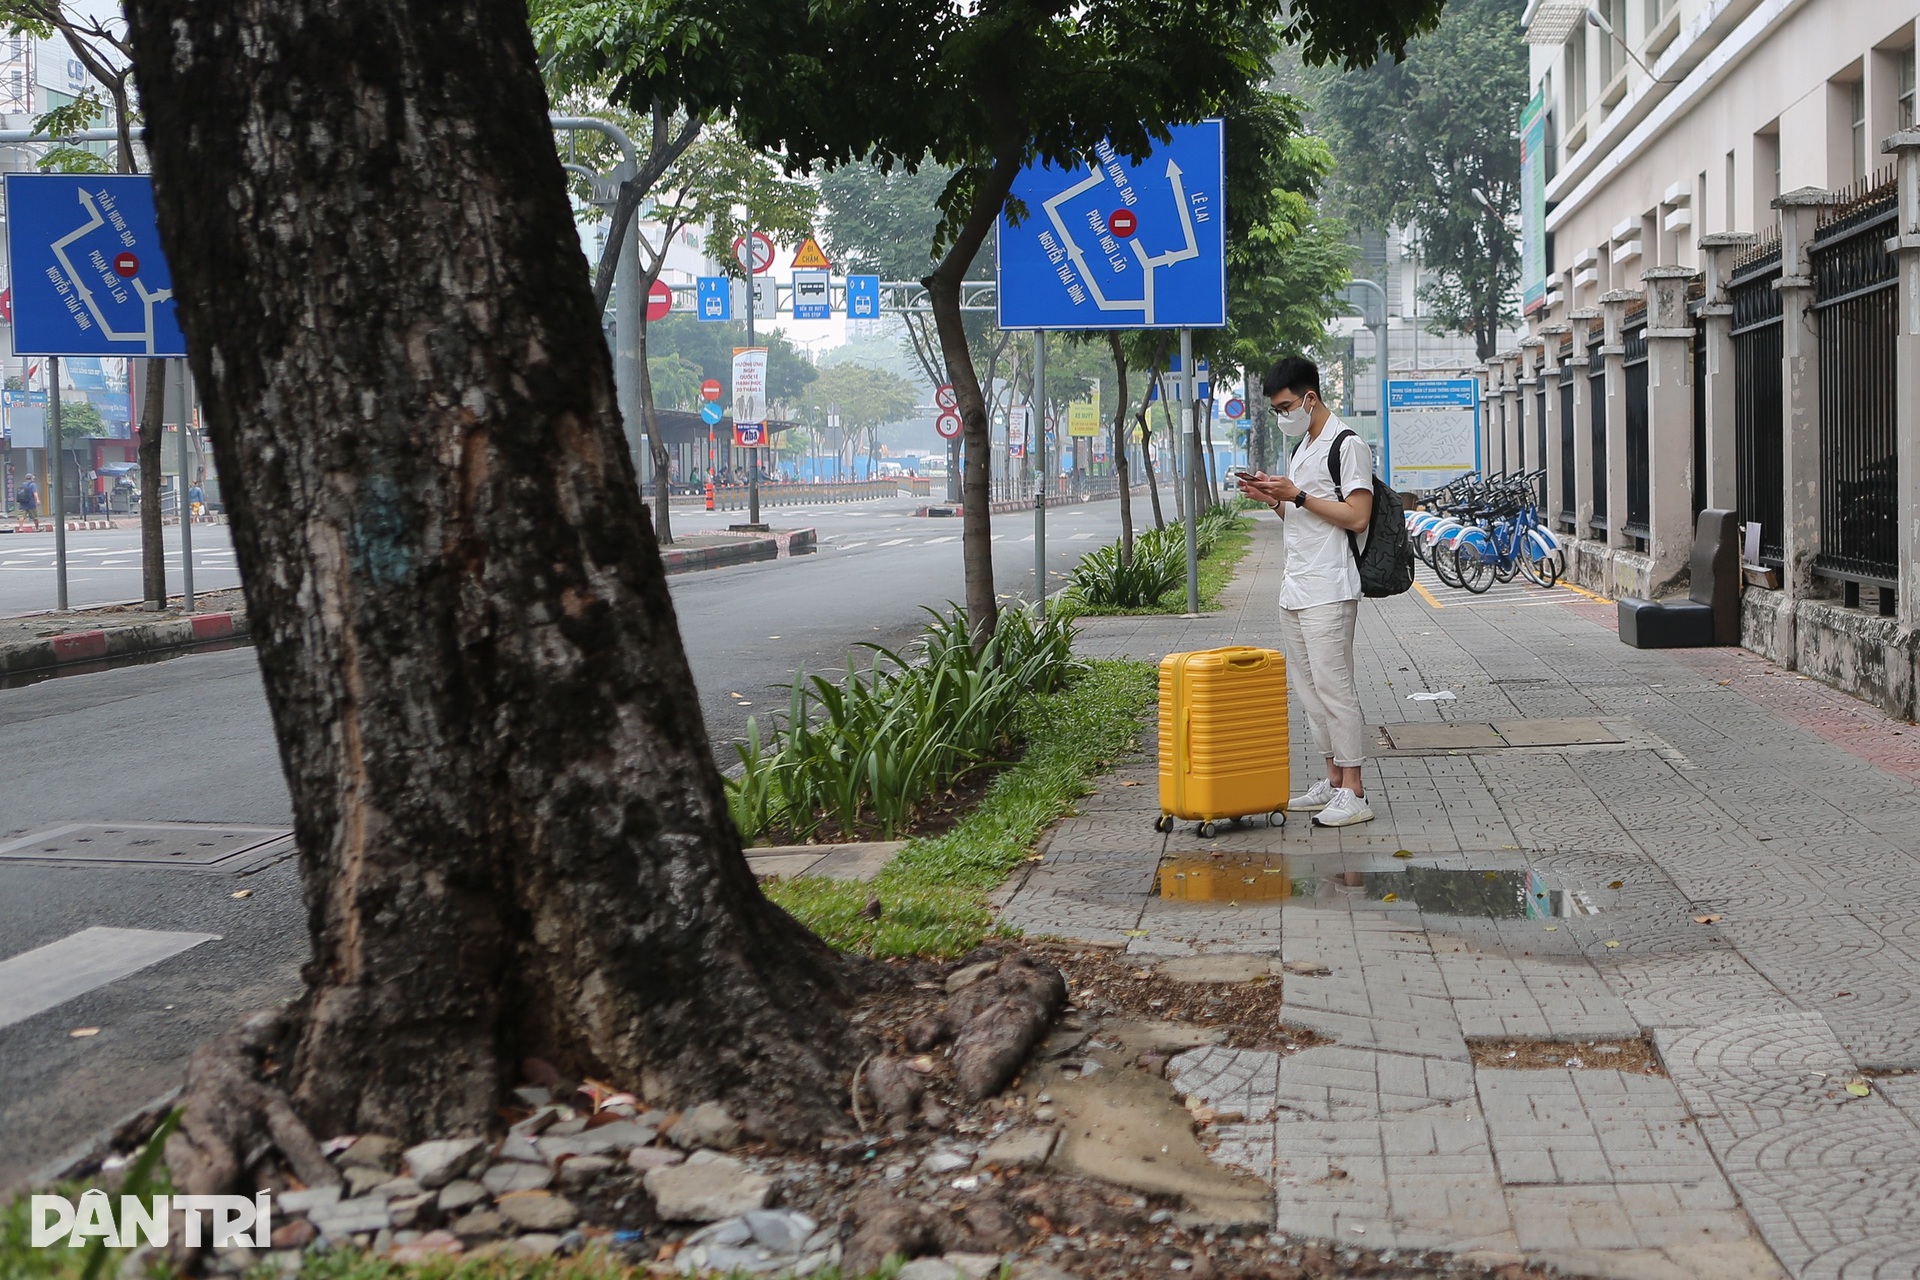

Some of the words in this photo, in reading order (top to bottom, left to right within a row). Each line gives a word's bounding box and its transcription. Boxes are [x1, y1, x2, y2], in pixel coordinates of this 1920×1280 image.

[1107, 162, 1128, 188] HƯNG
[1120, 186, 1138, 207] ĐẠO
[1191, 191, 1208, 205] LÊ
[96, 188, 116, 212] TRẦN
[120, 230, 136, 248] ĐẠO
[1086, 208, 1108, 236] PHẠM
[1194, 206, 1210, 223] LAI
[1099, 235, 1120, 255] NGŨ
[802, 254, 819, 264] CHẬM
[1037, 230, 1067, 265] NGUYỄN
[1056, 262, 1076, 286] THÁI
[1066, 283, 1086, 306] BÌNH
[1108, 253, 1128, 273] LÃO
[88, 249, 109, 273] PHẠM
[102, 271, 120, 289] NGŨ
[111, 286, 127, 304] LÃO
[45, 265, 72, 296] NGUYỄN
[63, 294, 82, 314] THÁI
[74, 311, 91, 331] BÌNH
[744, 429, 758, 441] Aba
[946, 419, 952, 431] 5
